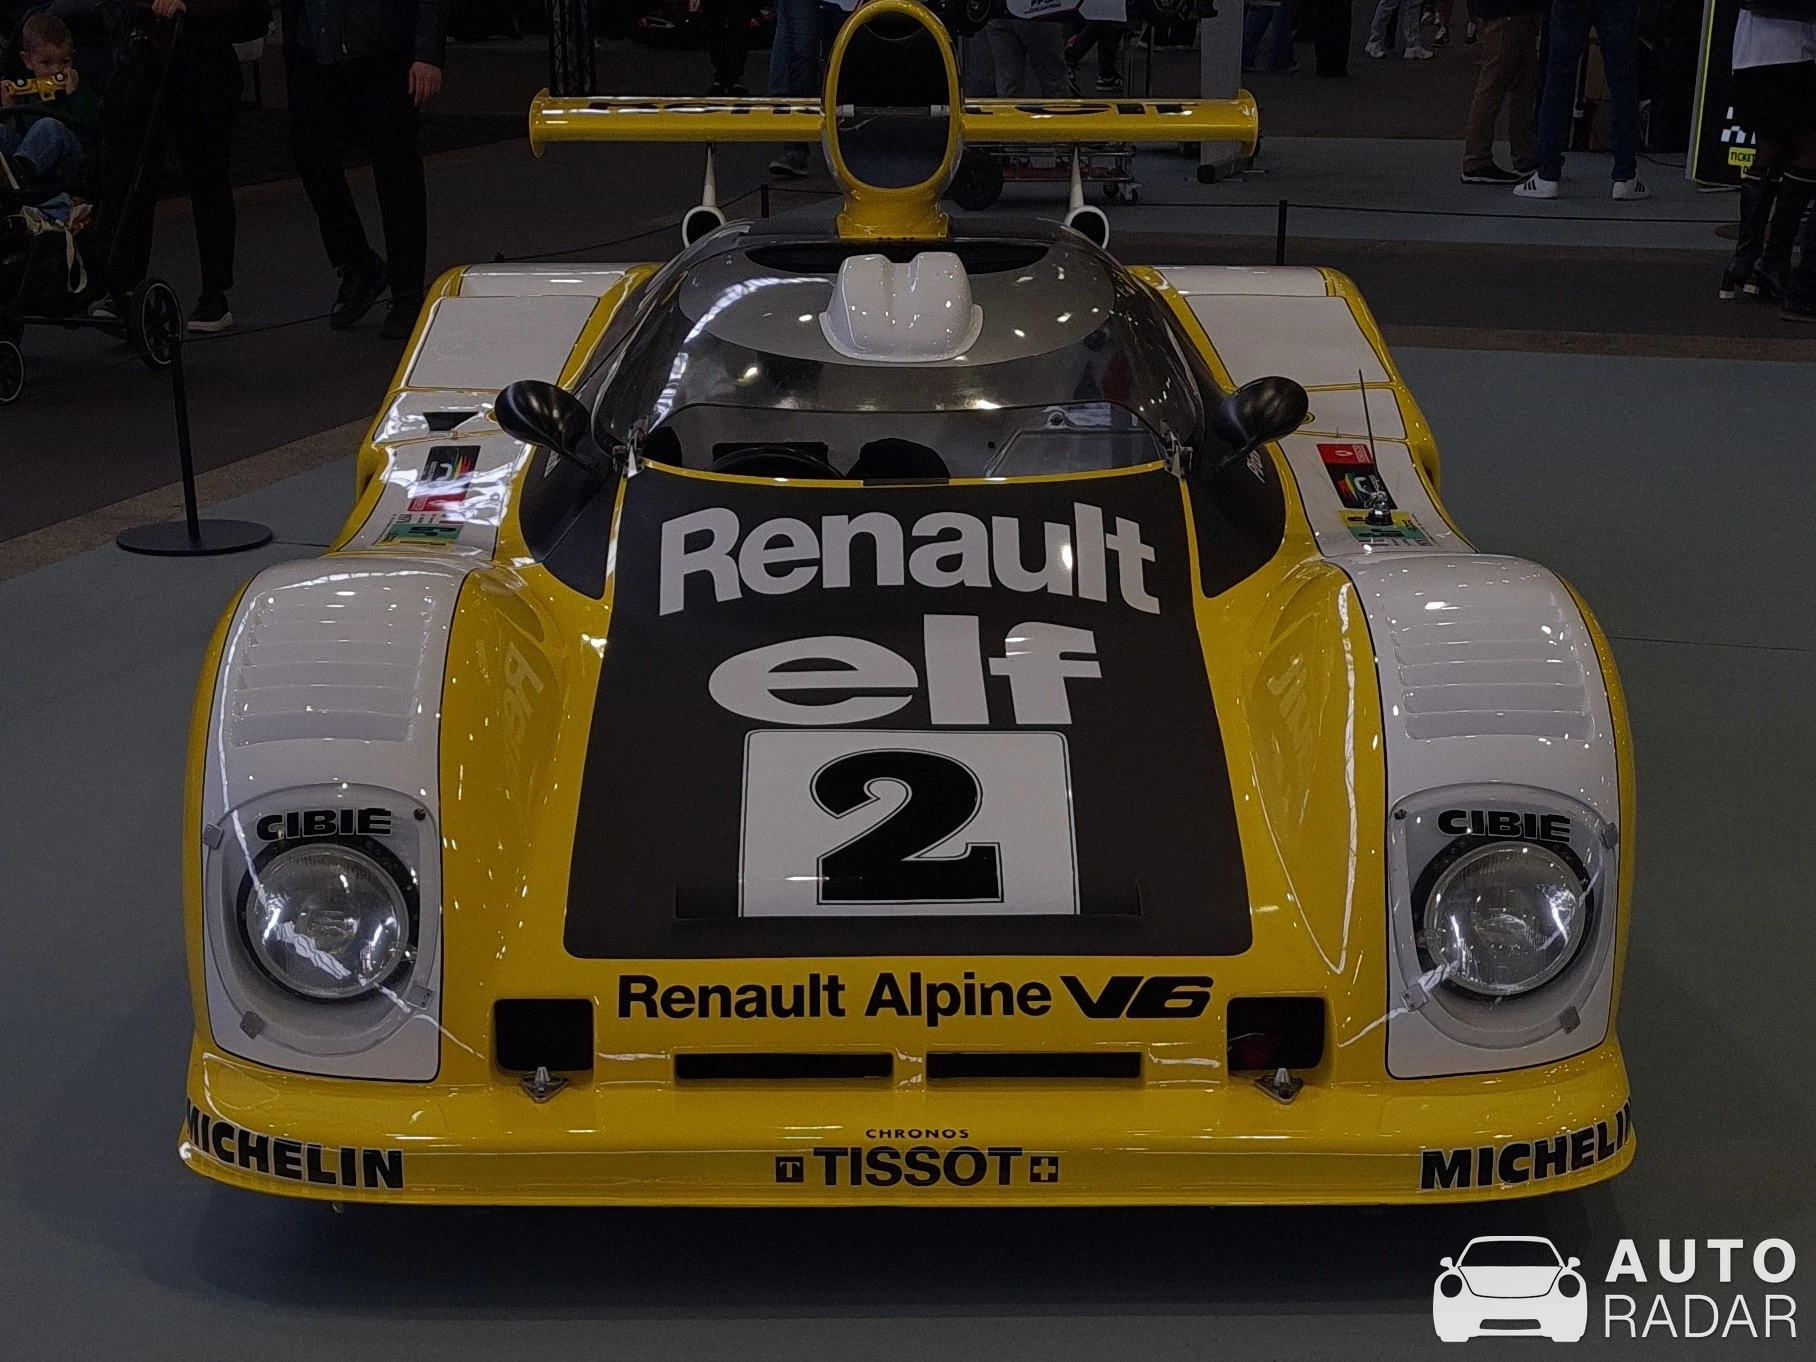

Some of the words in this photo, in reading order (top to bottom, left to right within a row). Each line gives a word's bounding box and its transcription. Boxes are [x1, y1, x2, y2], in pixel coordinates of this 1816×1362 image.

[660, 502, 1160, 616] Renault
[709, 614, 1102, 725] elf
[813, 750, 1002, 902] 2
[619, 974, 845, 1018] Renault
[865, 972, 1051, 1027] Alpine
[1060, 975, 1213, 1018] V6
[187, 1097, 403, 1189] MICHELIN
[813, 1146, 1023, 1186] TISSOT
[865, 1128, 970, 1139] CHRONOS
